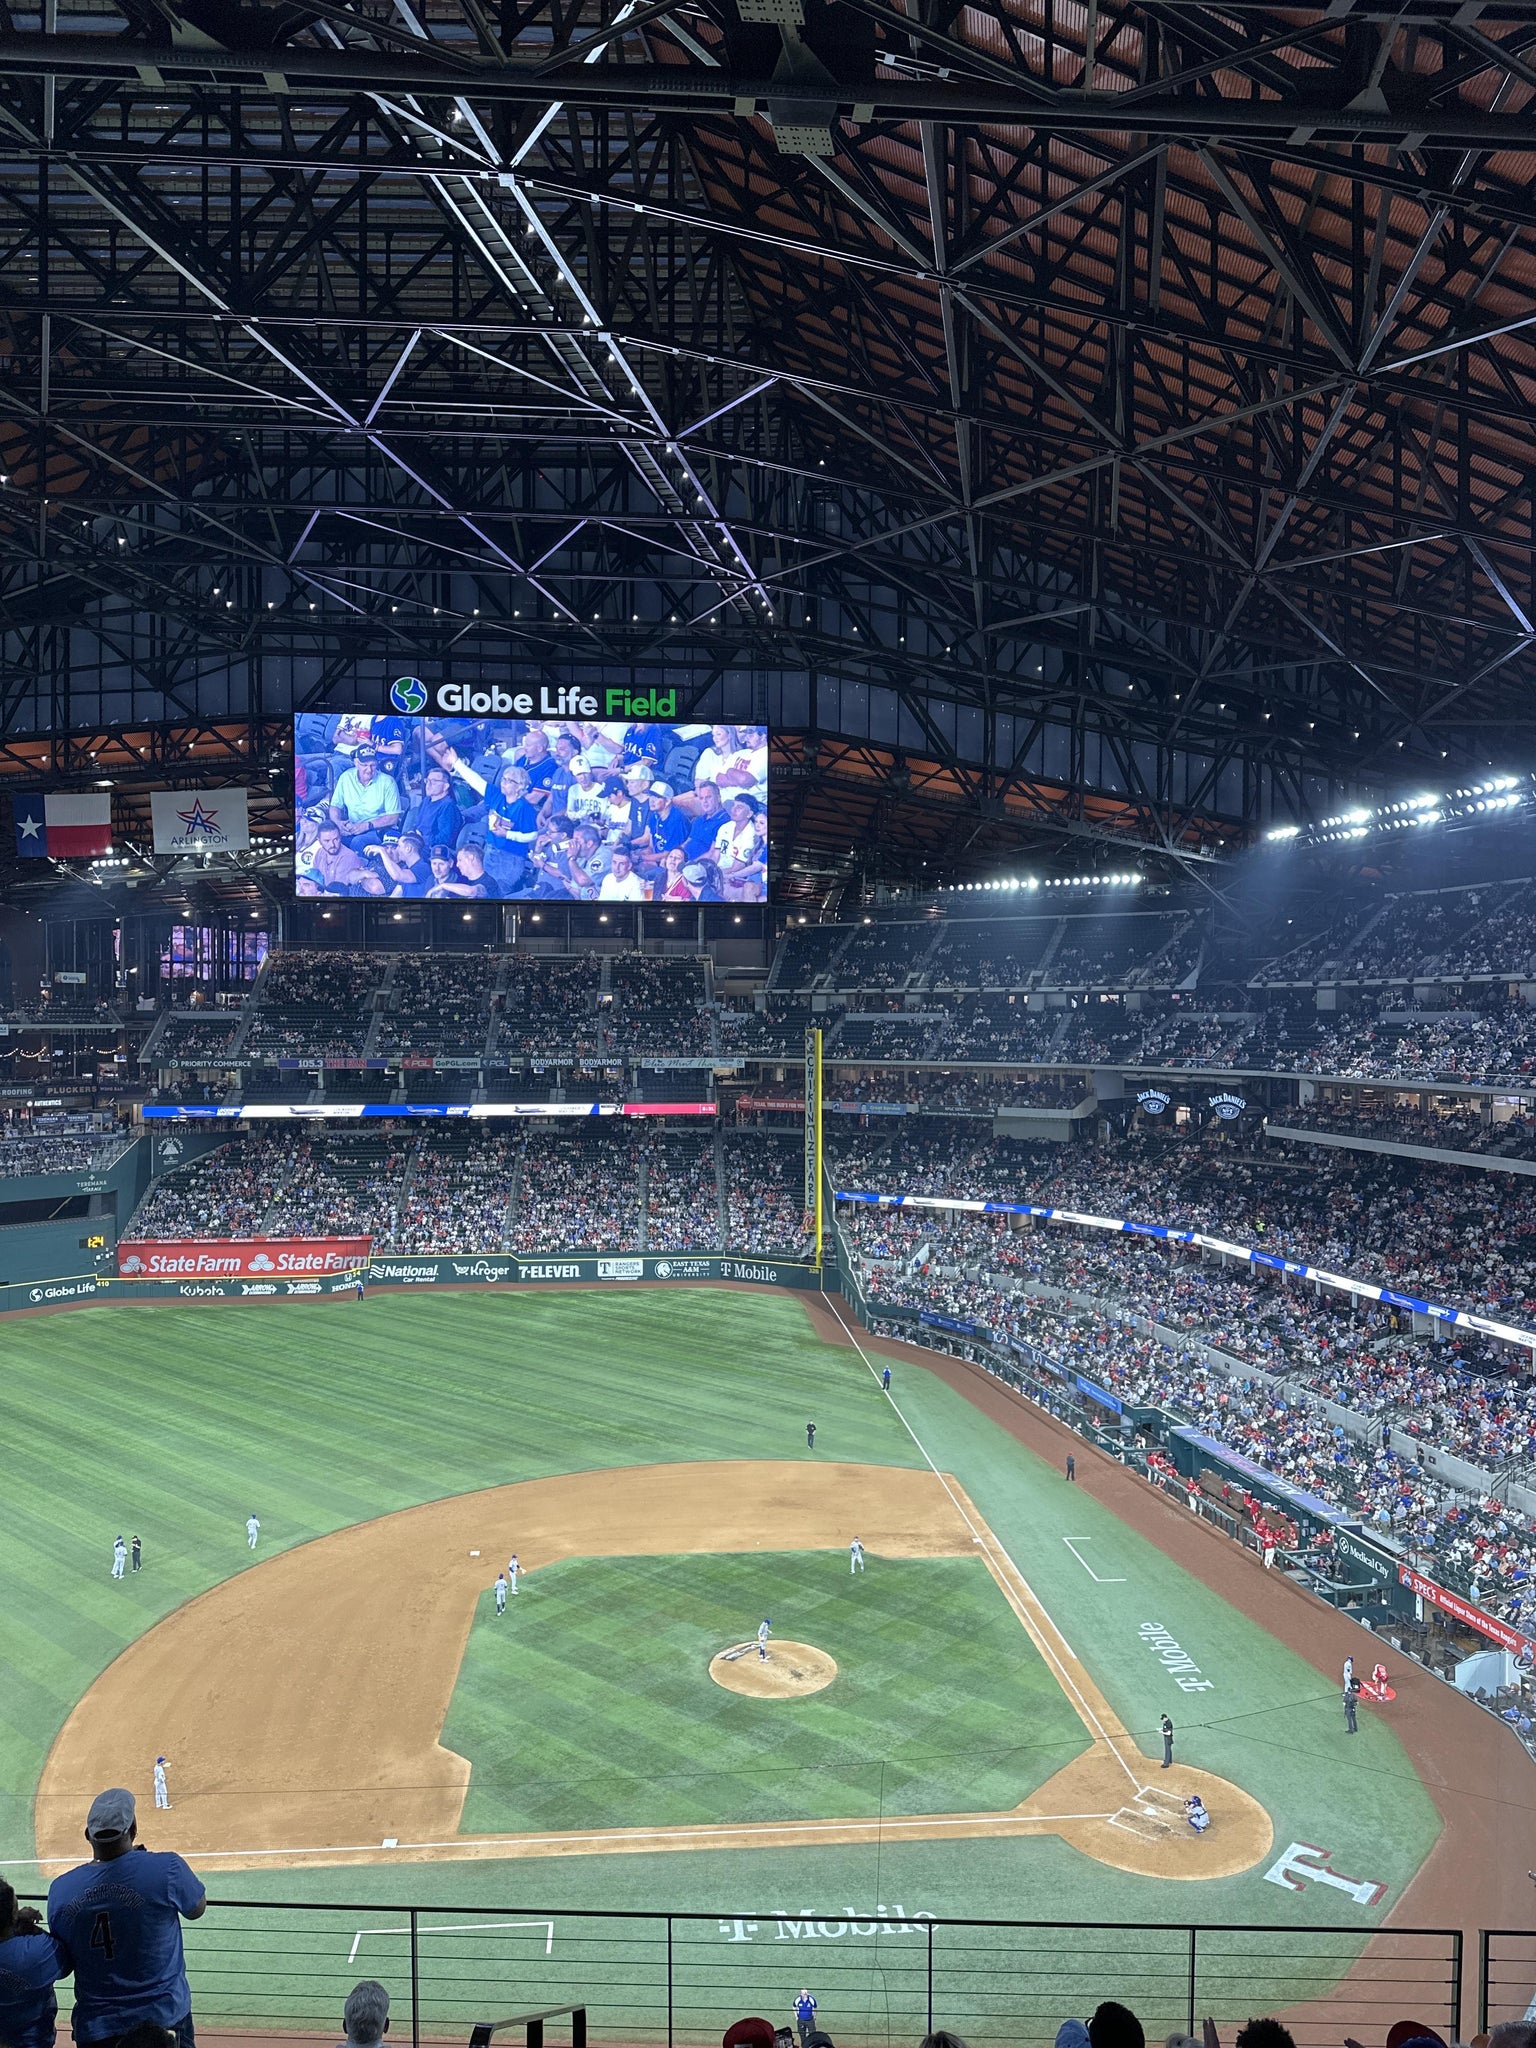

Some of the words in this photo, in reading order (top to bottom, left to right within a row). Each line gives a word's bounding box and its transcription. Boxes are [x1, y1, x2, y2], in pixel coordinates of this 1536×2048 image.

[437, 684, 533, 714] Globe
[541, 686, 598, 716] Life
[605, 688, 676, 717] Field
[170, 835, 228, 846] ARLINGTON
[298, 1060, 323, 1068] 105.3
[325, 1060, 343, 1068] THE
[346, 1060, 367, 1068] FAN
[531, 1058, 574, 1066] BODYARMOR
[580, 1058, 623, 1066] BODYARMOR
[47, 1086, 97, 1095] PLUCKERS
[1136, 1092, 1150, 1103] JACK
[1149, 1089, 1171, 1105] DANIEL'S
[34, 1099, 62, 1107] AUTHENTICS
[1208, 1095, 1223, 1107] JACK
[1223, 1092, 1247, 1109] DANIEL'S
[470, 1260, 510, 1282] Kroger
[734, 1263, 777, 1282] Mobile
[45, 1285, 75, 1298] Globe
[77, 1283, 96, 1294] Life
[180, 1285, 225, 1297] Kubota
[331, 1280, 363, 1293] HONDA
[1349, 1544, 1375, 1569] Medical
[1375, 1561, 1389, 1579] City
[1413, 1578, 1437, 1601] SPEC'S
[1137, 1622, 1202, 1675] Mobile
[770, 1904, 941, 1940] Mobile
[90, 1910, 117, 1961] 4
